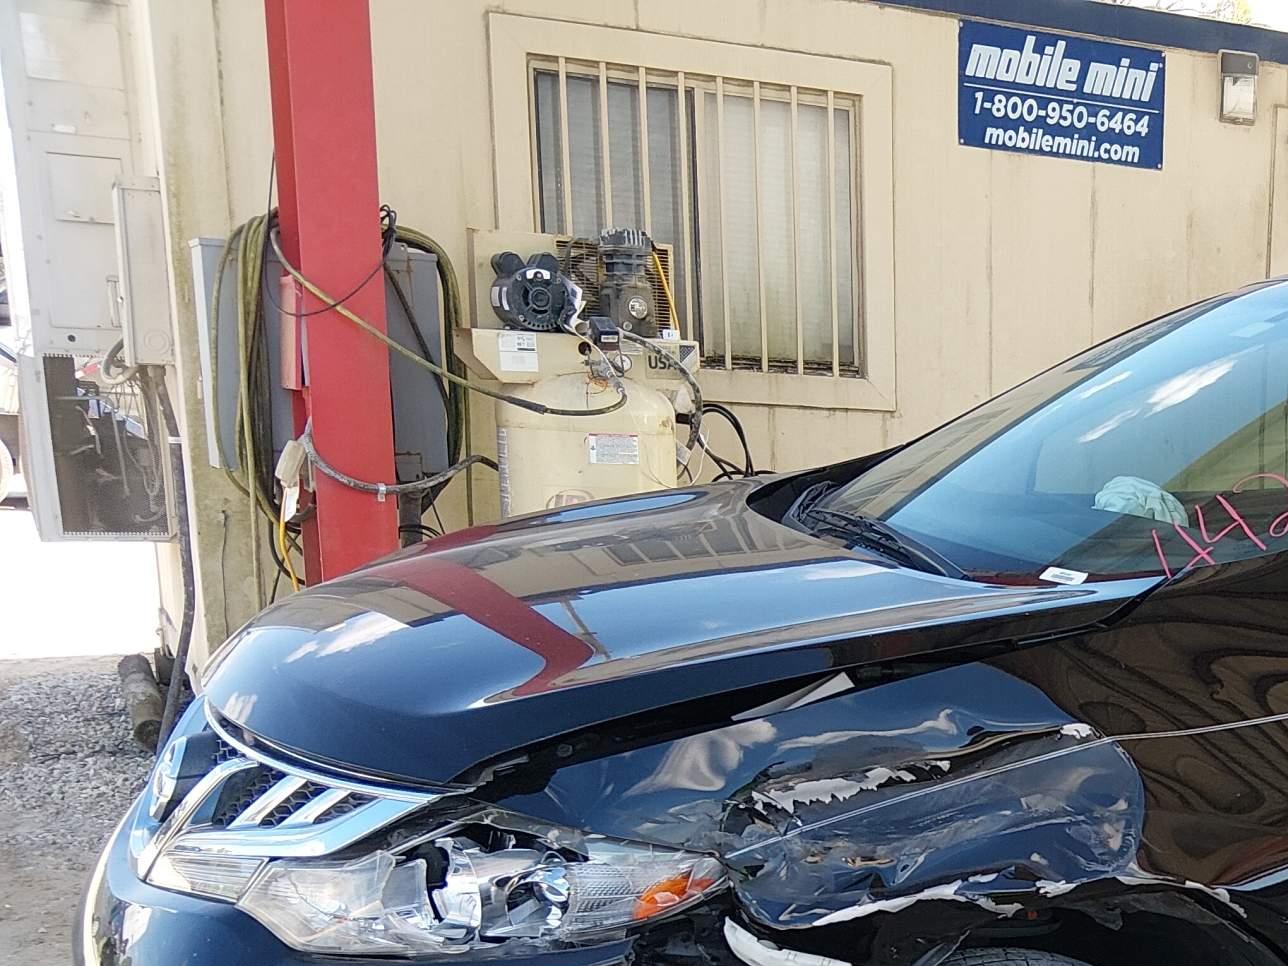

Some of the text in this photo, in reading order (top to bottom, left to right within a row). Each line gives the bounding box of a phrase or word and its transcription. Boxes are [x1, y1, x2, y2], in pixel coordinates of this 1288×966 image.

[964, 35, 1159, 102] mobile mini
[974, 91, 1150, 137] 1-800-950-6464
[984, 126, 1140, 163] mobilemini.com
